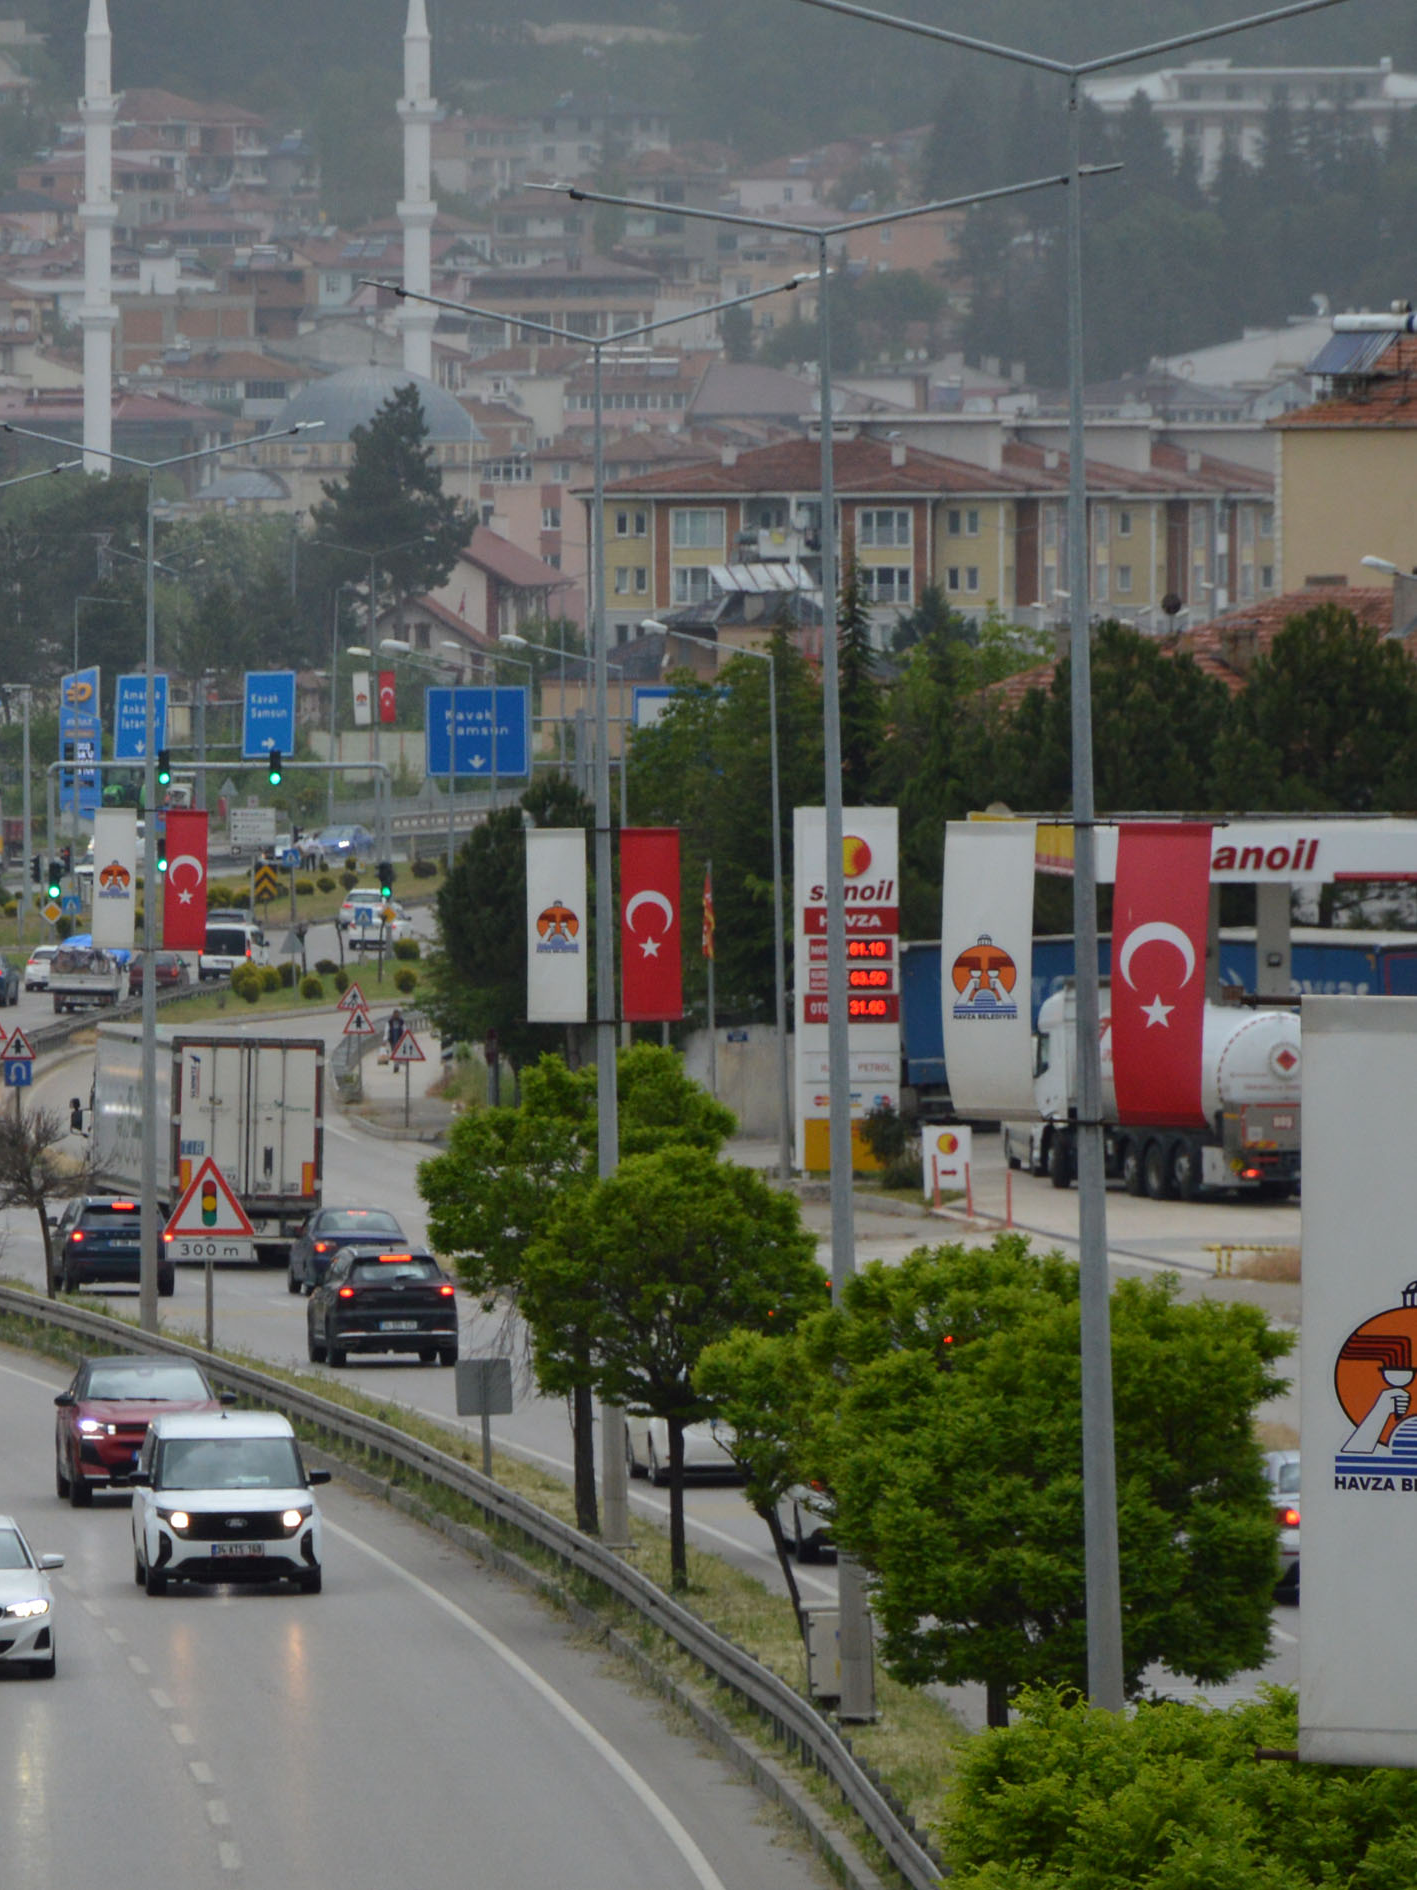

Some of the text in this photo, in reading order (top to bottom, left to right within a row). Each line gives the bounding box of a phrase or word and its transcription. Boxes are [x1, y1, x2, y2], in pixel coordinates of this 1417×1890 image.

[251, 707, 287, 719] Samsun
[1212, 838, 1320, 871] anoil
[809, 880, 894, 901] snoil
[819, 914, 882, 928] HVZA
[180, 1243, 239, 1257] 300 m
[1335, 1476, 1417, 1492] HAVZA B
